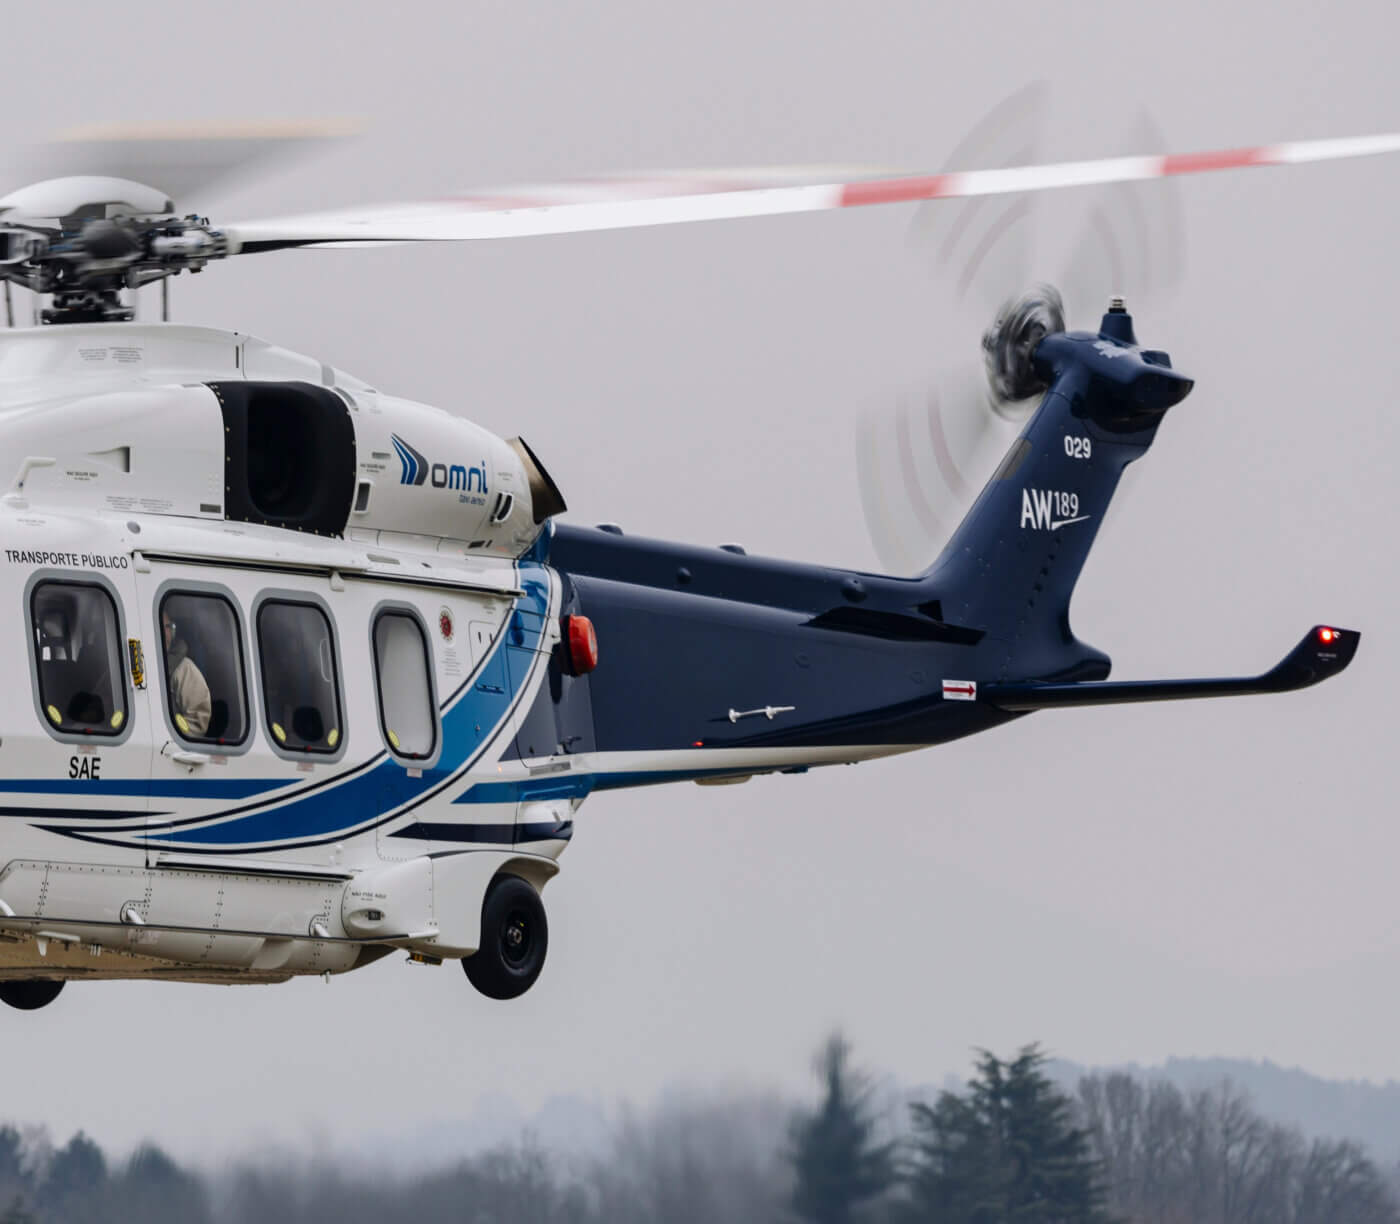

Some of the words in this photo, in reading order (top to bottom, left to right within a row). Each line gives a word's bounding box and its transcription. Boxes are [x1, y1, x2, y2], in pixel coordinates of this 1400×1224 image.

[1064, 435, 1091, 459] 029
[431, 460, 488, 494] omni
[5, 549, 80, 566] TRANSPORTE
[81, 552, 128, 569] PÚBLICO
[68, 756, 102, 780] SAE
